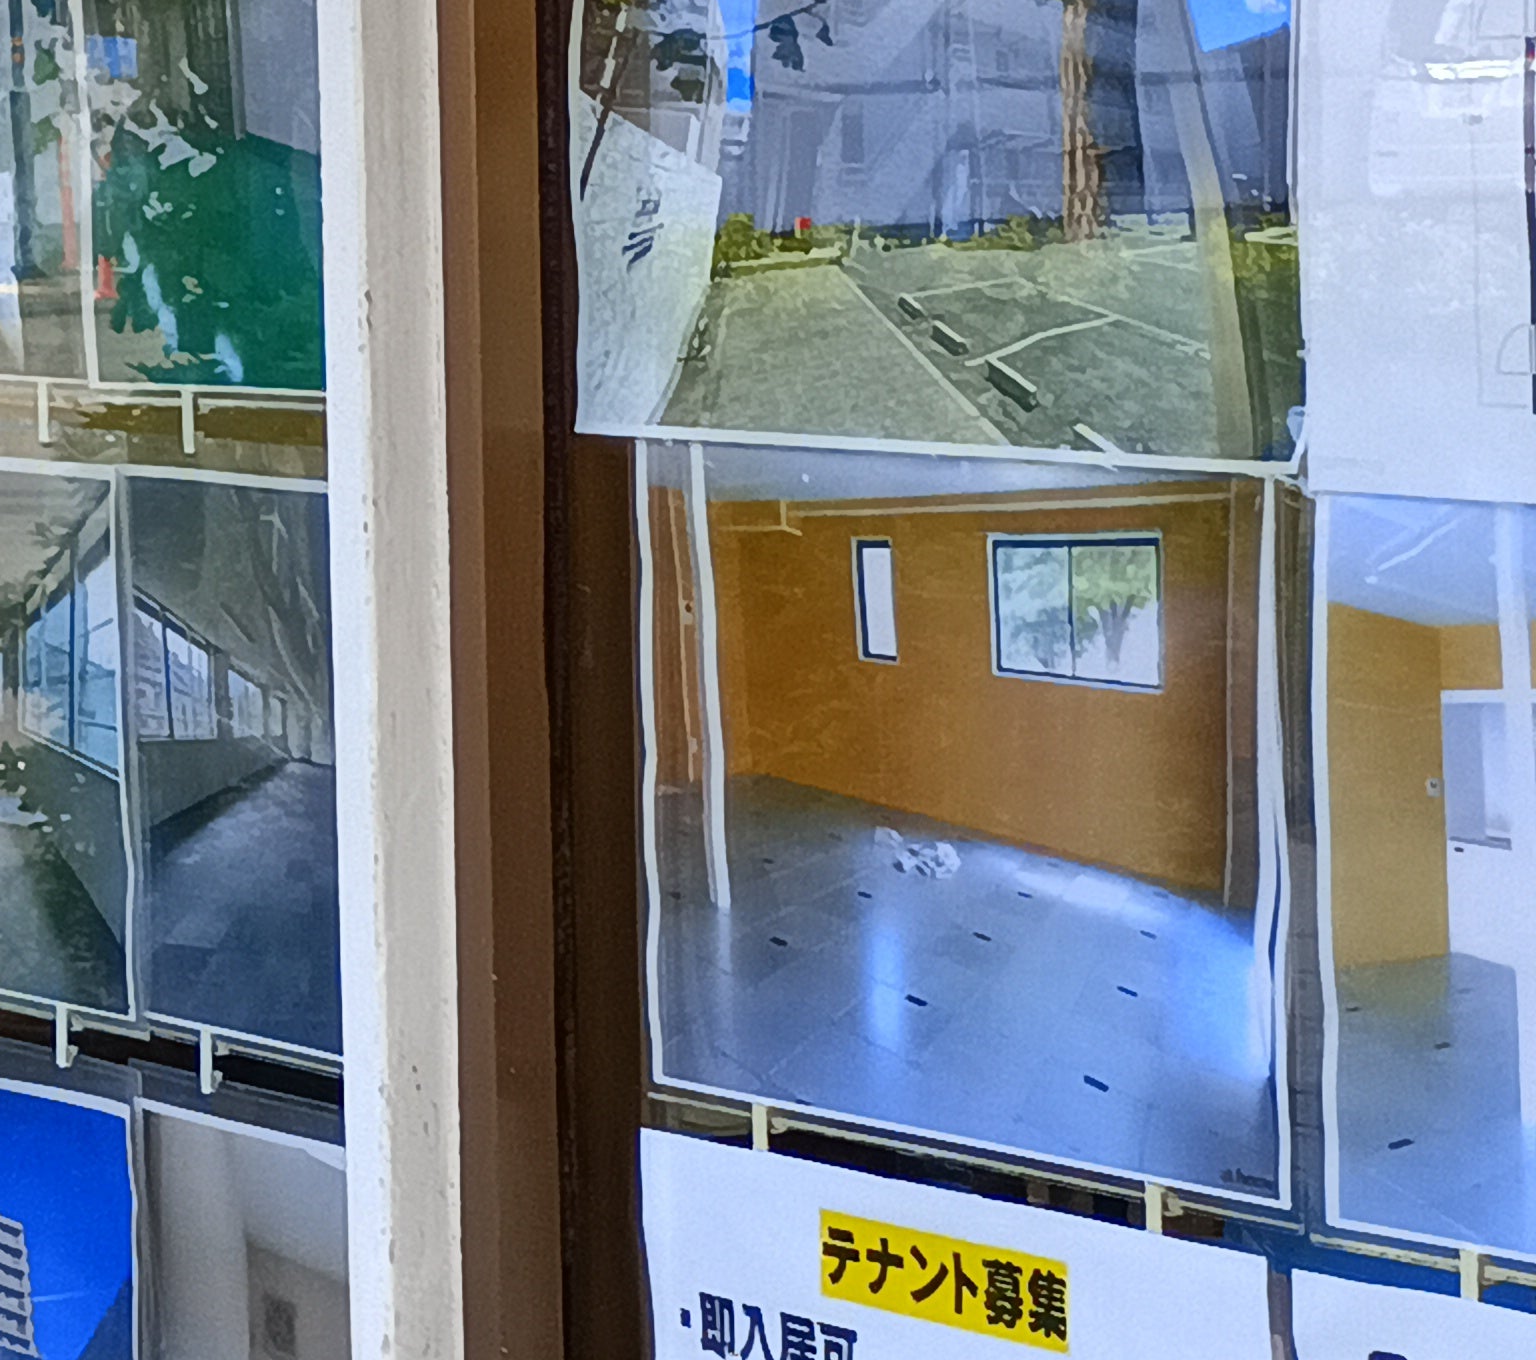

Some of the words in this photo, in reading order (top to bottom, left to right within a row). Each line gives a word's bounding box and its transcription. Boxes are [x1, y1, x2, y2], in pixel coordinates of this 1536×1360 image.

[821, 1225, 1068, 1342] テナント募集
